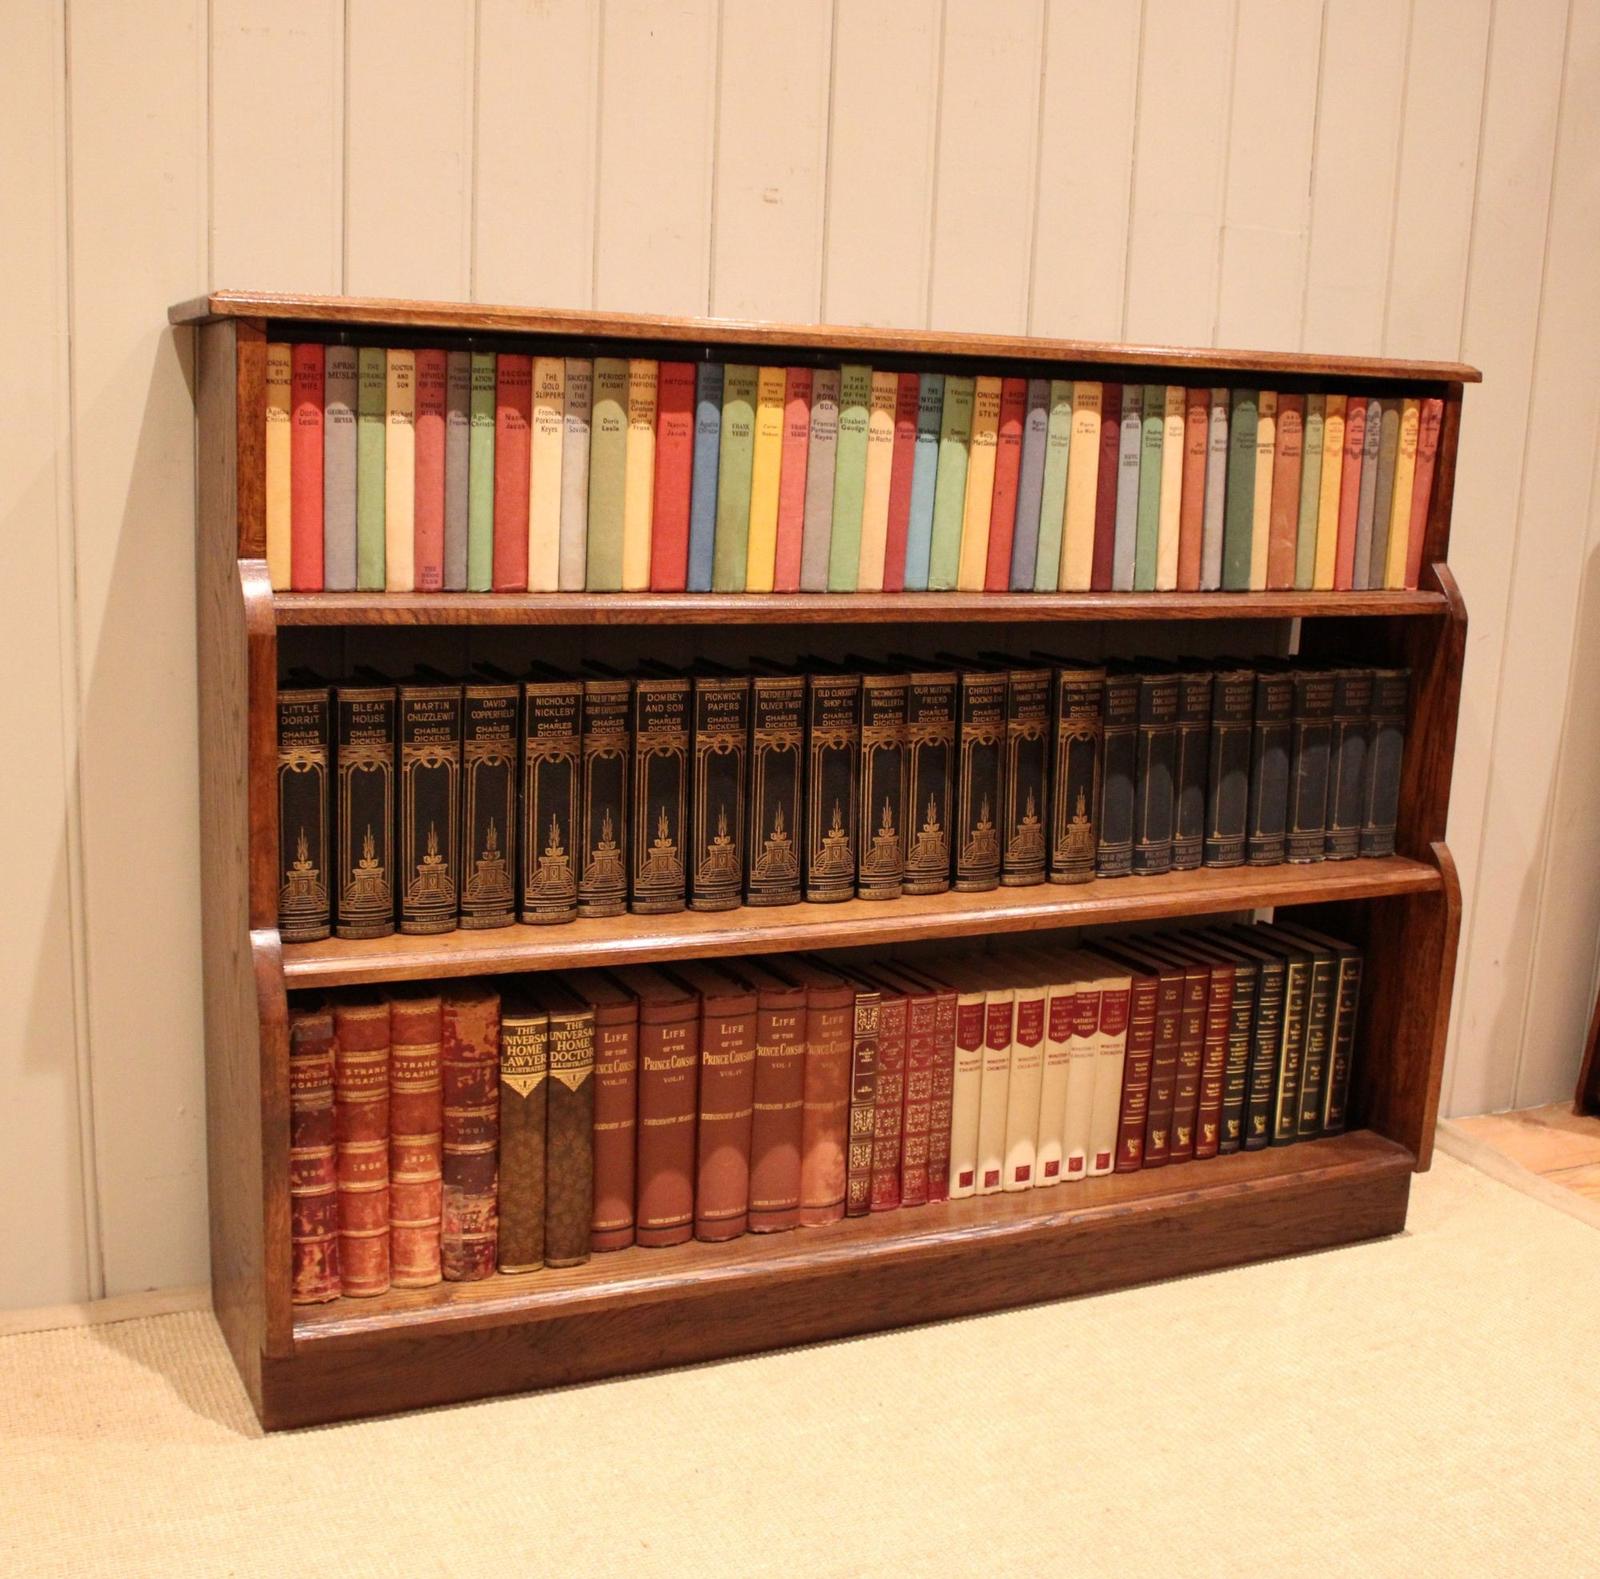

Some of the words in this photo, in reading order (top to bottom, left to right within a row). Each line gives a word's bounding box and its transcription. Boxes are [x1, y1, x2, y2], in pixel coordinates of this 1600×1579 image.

[541, 426, 558, 435] Keyes
[647, 694, 683, 702] DOMBEY
[705, 692, 741, 701] PICKWICK
[536, 697, 575, 705] NICHOLAS
[282, 704, 319, 714] LITTLE
[353, 704, 385, 712] BLEAK
[414, 702, 450, 710] MARTIN
[645, 704, 664, 712] AND
[761, 702, 783, 710] OLIVER
[535, 708, 575, 717] NICKLEBY
[281, 716, 319, 724] DORRIT
[352, 715, 384, 723] HOUSE
[407, 712, 454, 722] CHUZZLEWIT
[766, 714, 797, 722] CHARLES
[538, 722, 572, 730] CHARLES
[592, 719, 624, 727] CHARLES
[592, 726, 624, 734] DICKENS
[566, 1021, 584, 1030] THE
[516, 1027, 536, 1035] THE
[557, 1038, 590, 1050] HOME
[507, 1044, 542, 1056] HOME
[551, 1048, 594, 1061] DOCTOR
[703, 1052, 729, 1065] PRINCE
[395, 1060, 437, 1068] STRAND
[500, 1054, 546, 1066] LAWYER
[644, 1057, 670, 1070] PRINCE
[346, 1066, 386, 1075] STRAND
[291, 1079, 333, 1088] AGAZINE
